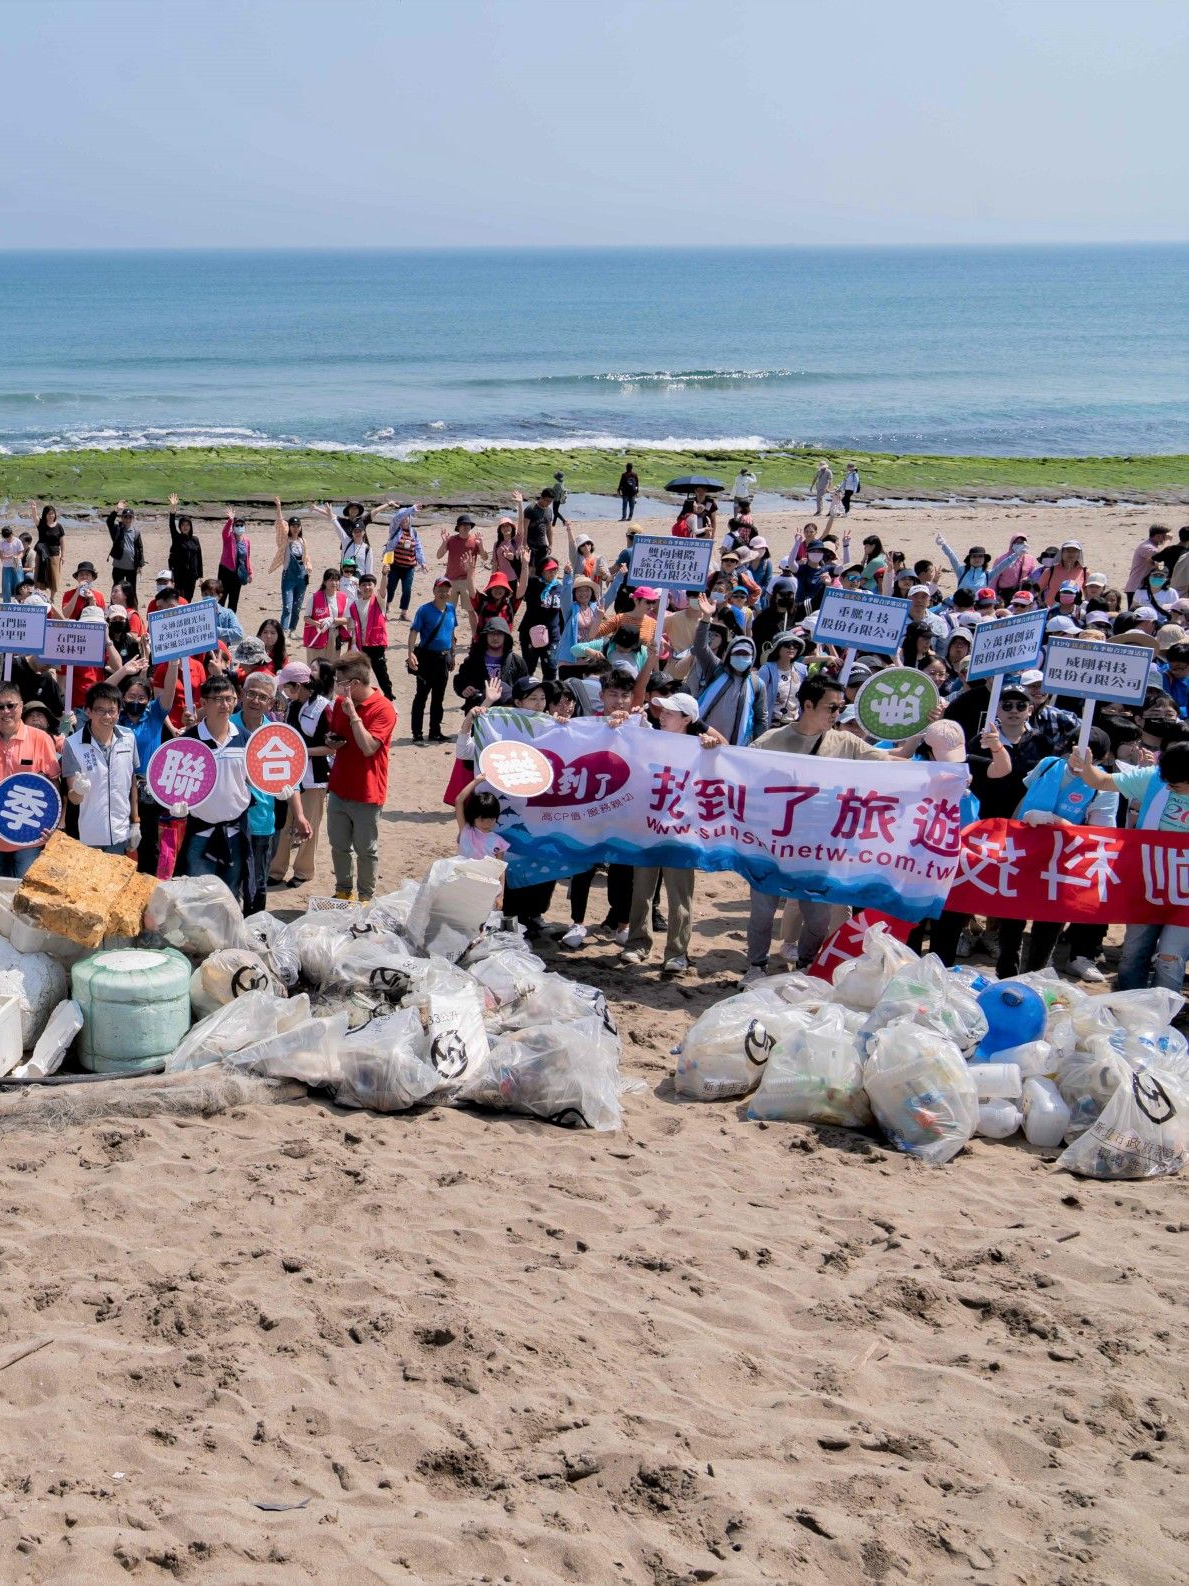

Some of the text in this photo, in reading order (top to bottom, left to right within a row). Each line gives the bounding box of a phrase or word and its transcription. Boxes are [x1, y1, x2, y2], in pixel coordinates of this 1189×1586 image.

[639, 557, 698, 571] 綜合旅行社
[648, 547, 696, 560] 雙向國際
[632, 567, 704, 582] 股份有限公司
[839, 606, 890, 624] 重鵬生技
[56, 633, 87, 644] 石門區
[821, 617, 899, 640] 股份有限公司
[983, 628, 1036, 650] 立萬利創新
[56, 644, 87, 655] 茂林里
[973, 641, 1038, 666] 股份有限公司
[1065, 656, 1129, 675] 威剛科技
[1048, 667, 1142, 691] 股份有限公司
[256, 735, 296, 782] 合
[157, 748, 207, 800] 聯
[548, 766, 612, 801] 到了
[0, 784, 49, 831] 季
[649, 765, 961, 858] 找到了旅遊
